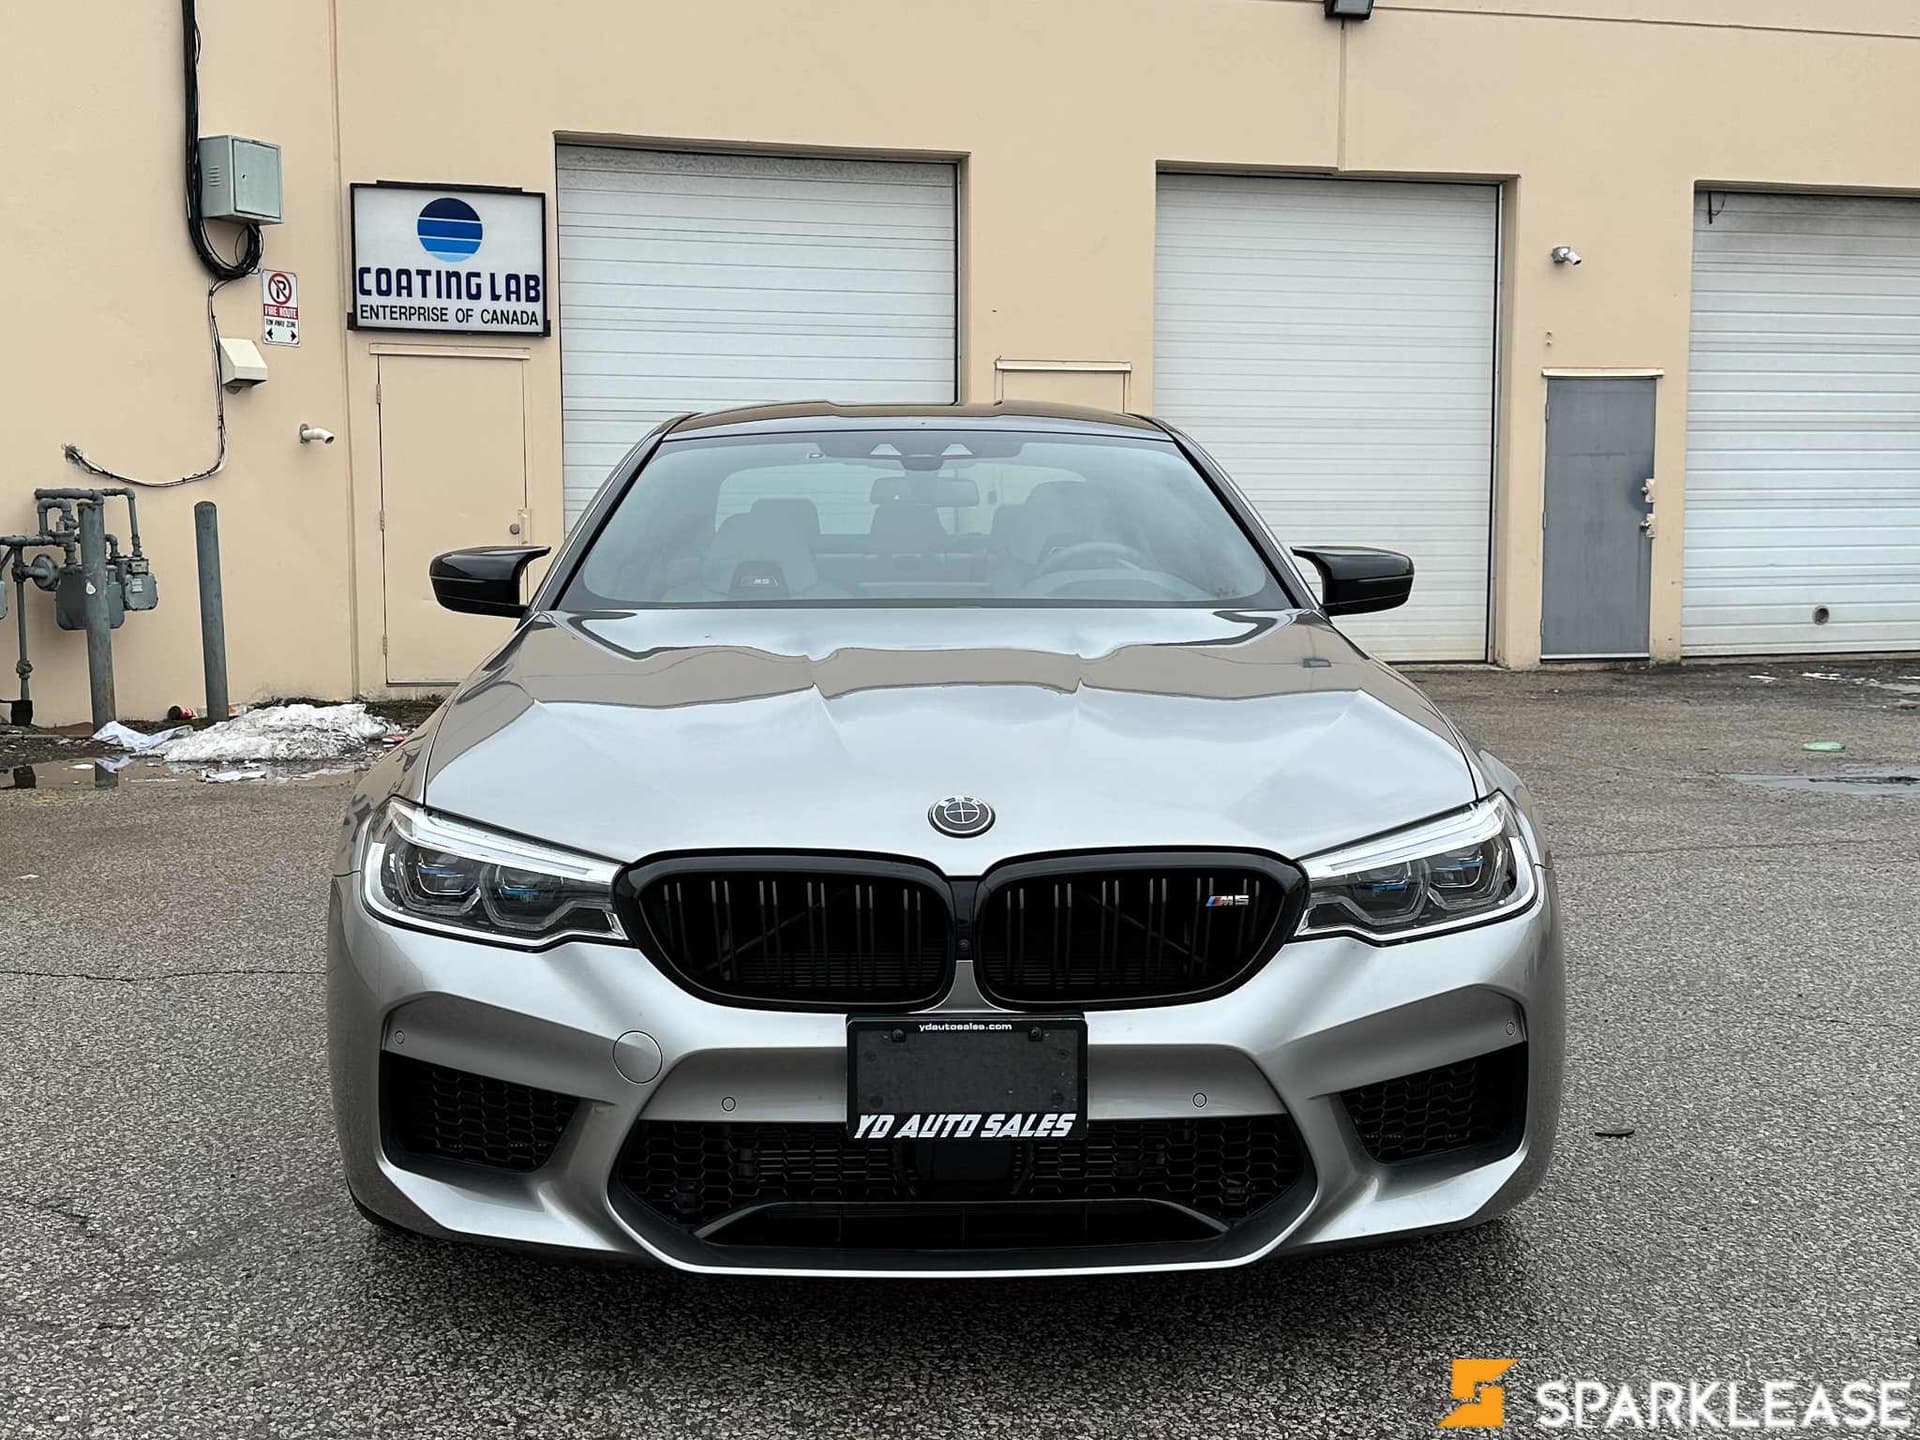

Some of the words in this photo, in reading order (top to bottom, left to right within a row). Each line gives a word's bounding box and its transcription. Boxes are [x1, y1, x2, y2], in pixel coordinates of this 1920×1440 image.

[358, 267, 482, 300] COATING
[490, 273, 541, 303] LAB
[360, 304, 449, 322] ENTERPRISE
[455, 308, 474, 323] OF
[480, 310, 539, 326] CANADA
[919, 1022, 1013, 1032] ydautosales.com
[854, 1114, 895, 1139] YD
[894, 1114, 982, 1139] AUTO
[980, 1113, 1077, 1138] SALES
